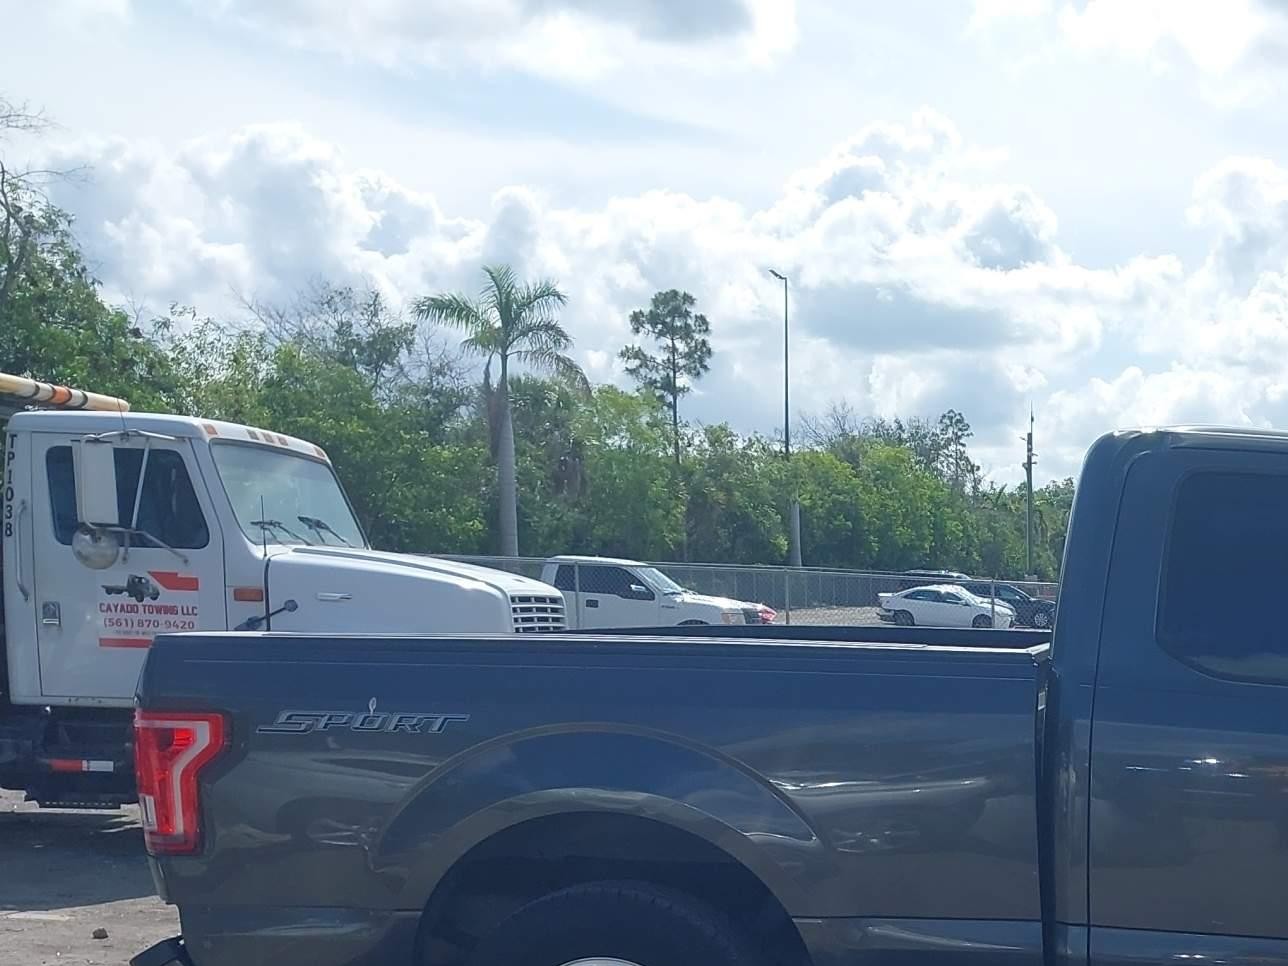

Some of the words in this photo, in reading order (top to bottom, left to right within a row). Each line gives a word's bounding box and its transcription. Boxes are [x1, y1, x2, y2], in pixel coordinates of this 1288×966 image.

[4, 433, 18, 537] TP1038
[142, 604, 178, 616] TOWING
[181, 606, 198, 616] LLC
[103, 617, 134, 629] (561)
[137, 619, 195, 630] 870-9420
[256, 710, 471, 735] SPORT
